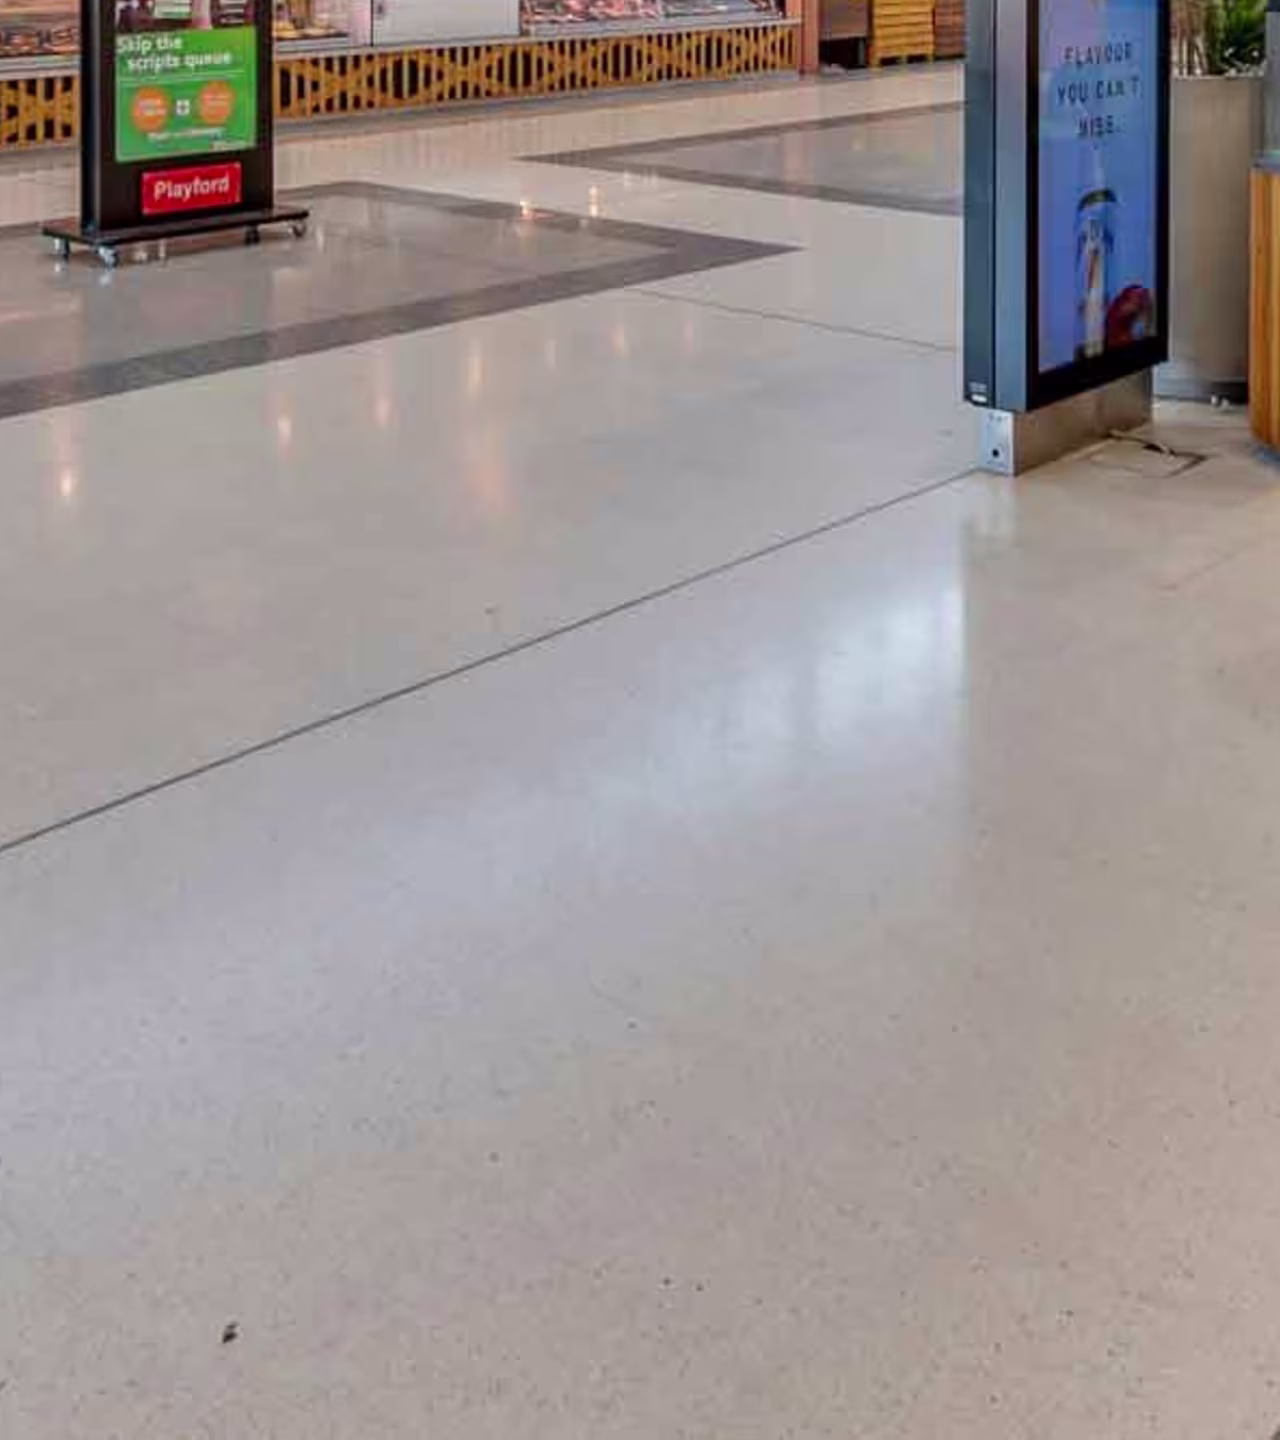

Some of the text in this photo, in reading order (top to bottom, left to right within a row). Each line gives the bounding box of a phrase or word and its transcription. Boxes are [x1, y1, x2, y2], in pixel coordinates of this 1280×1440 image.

[116, 33, 183, 55] Skip the
[1064, 41, 1132, 67] FLAVOUR
[127, 50, 232, 74] scripts queue
[1057, 79, 1089, 105] YOU
[153, 173, 230, 202] Playford
